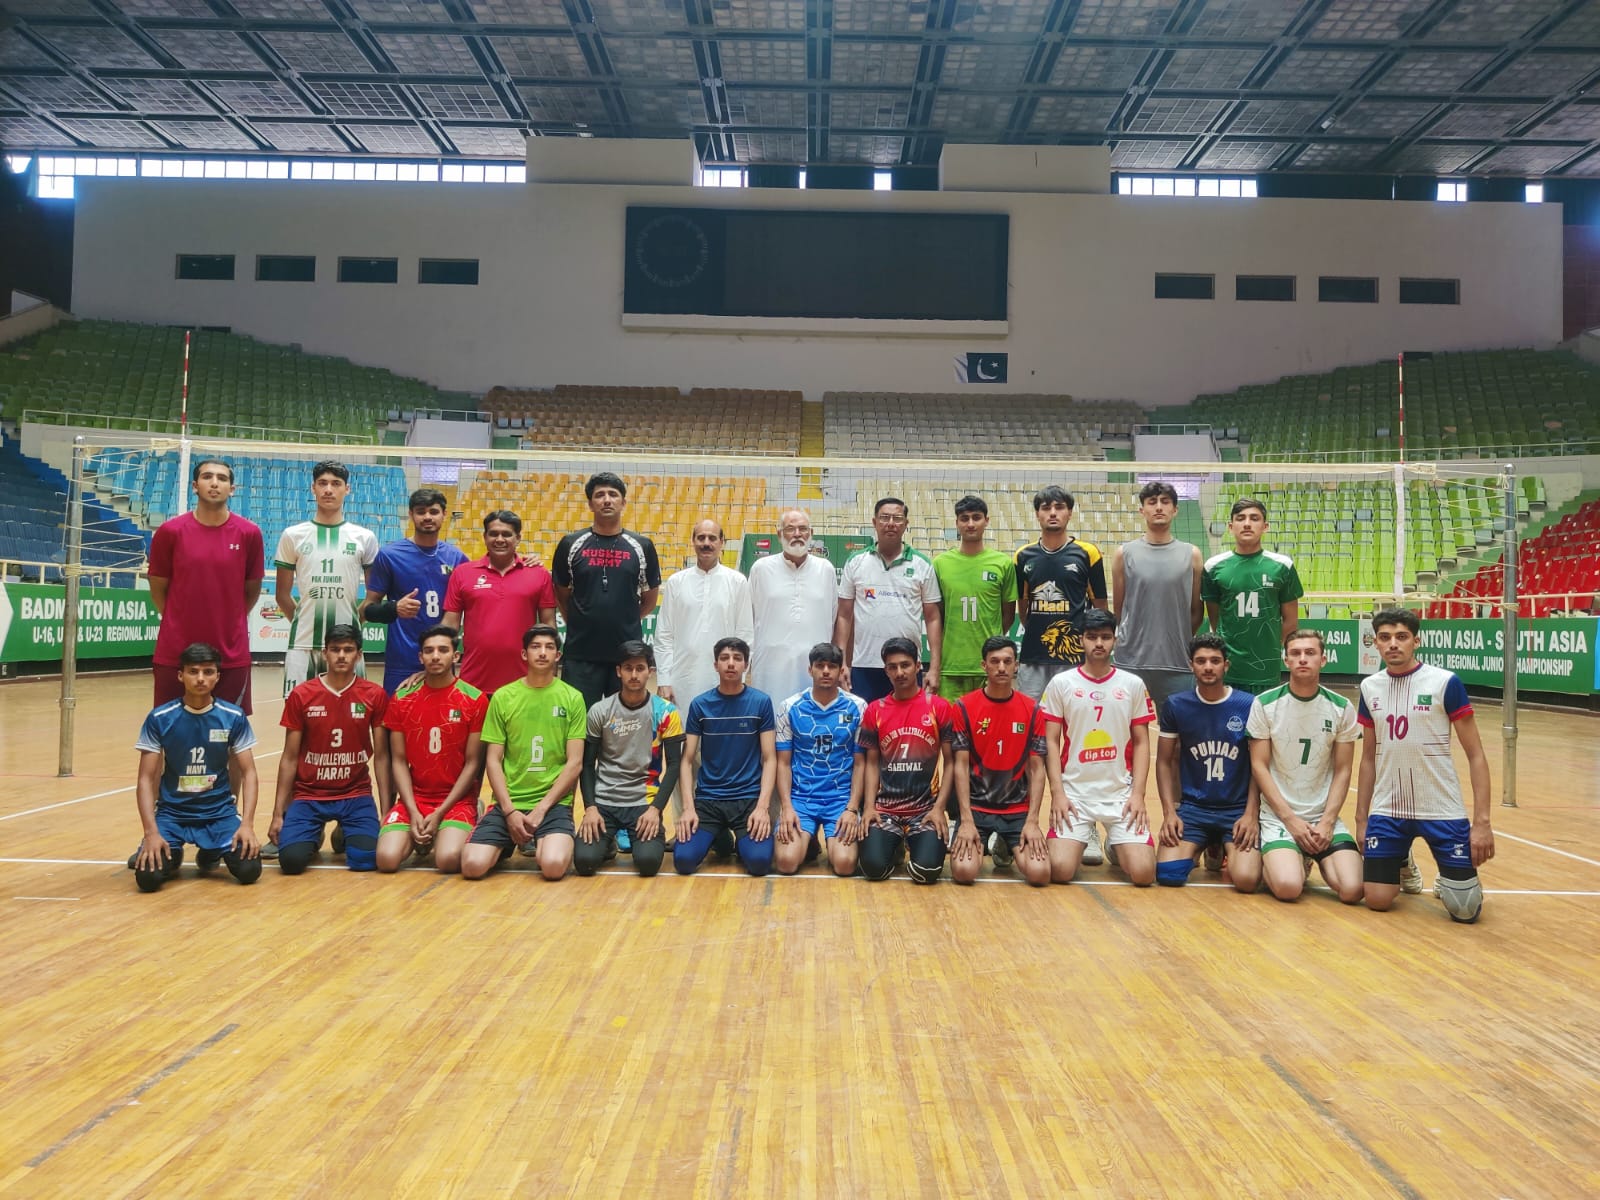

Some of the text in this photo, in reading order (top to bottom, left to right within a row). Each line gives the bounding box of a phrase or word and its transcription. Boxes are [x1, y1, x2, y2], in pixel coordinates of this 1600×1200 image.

[321, 558, 334, 573] 11
[320, 587, 344, 599] FFC
[21, 597, 114, 620] BADMNTON
[117, 601, 148, 620] ASIA
[425, 590, 440, 618] 8
[960, 596, 977, 622] 11
[1038, 599, 1070, 612] Hadi
[1235, 591, 1260, 618] 14
[33, 626, 55, 646] U-16,
[86, 626, 103, 643] U-23
[106, 626, 143, 641] REGIONAL
[362, 627, 386, 641] ASIA
[1326, 630, 1351, 645] ASIA
[1455, 629, 1485, 650] ASIA
[1494, 630, 1545, 652] SUTH
[1550, 630, 1588, 653] ASIA
[1446, 654, 1481, 670] REGIONAL
[1481, 656, 1504, 672] JUNIO
[1516, 657, 1573, 677] HAMPIONSHIP
[1094, 706, 1103, 722] 7
[1386, 714, 1409, 741] 10
[330, 728, 343, 748] 3
[429, 726, 442, 754] 8
[813, 734, 833, 754] 15
[996, 739, 1004, 755] 1
[189, 747, 205, 764] 12
[531, 735, 544, 763] 6
[900, 743, 910, 759] 7
[1085, 748, 1116, 760] tip top
[1190, 740, 1240, 760] PUNJAB
[1299, 738, 1312, 765] 7
[186, 764, 207, 775] NAVY
[316, 767, 351, 780] HARAR
[887, 762, 924, 772] SAHIWAL
[1203, 757, 1225, 781] 14
